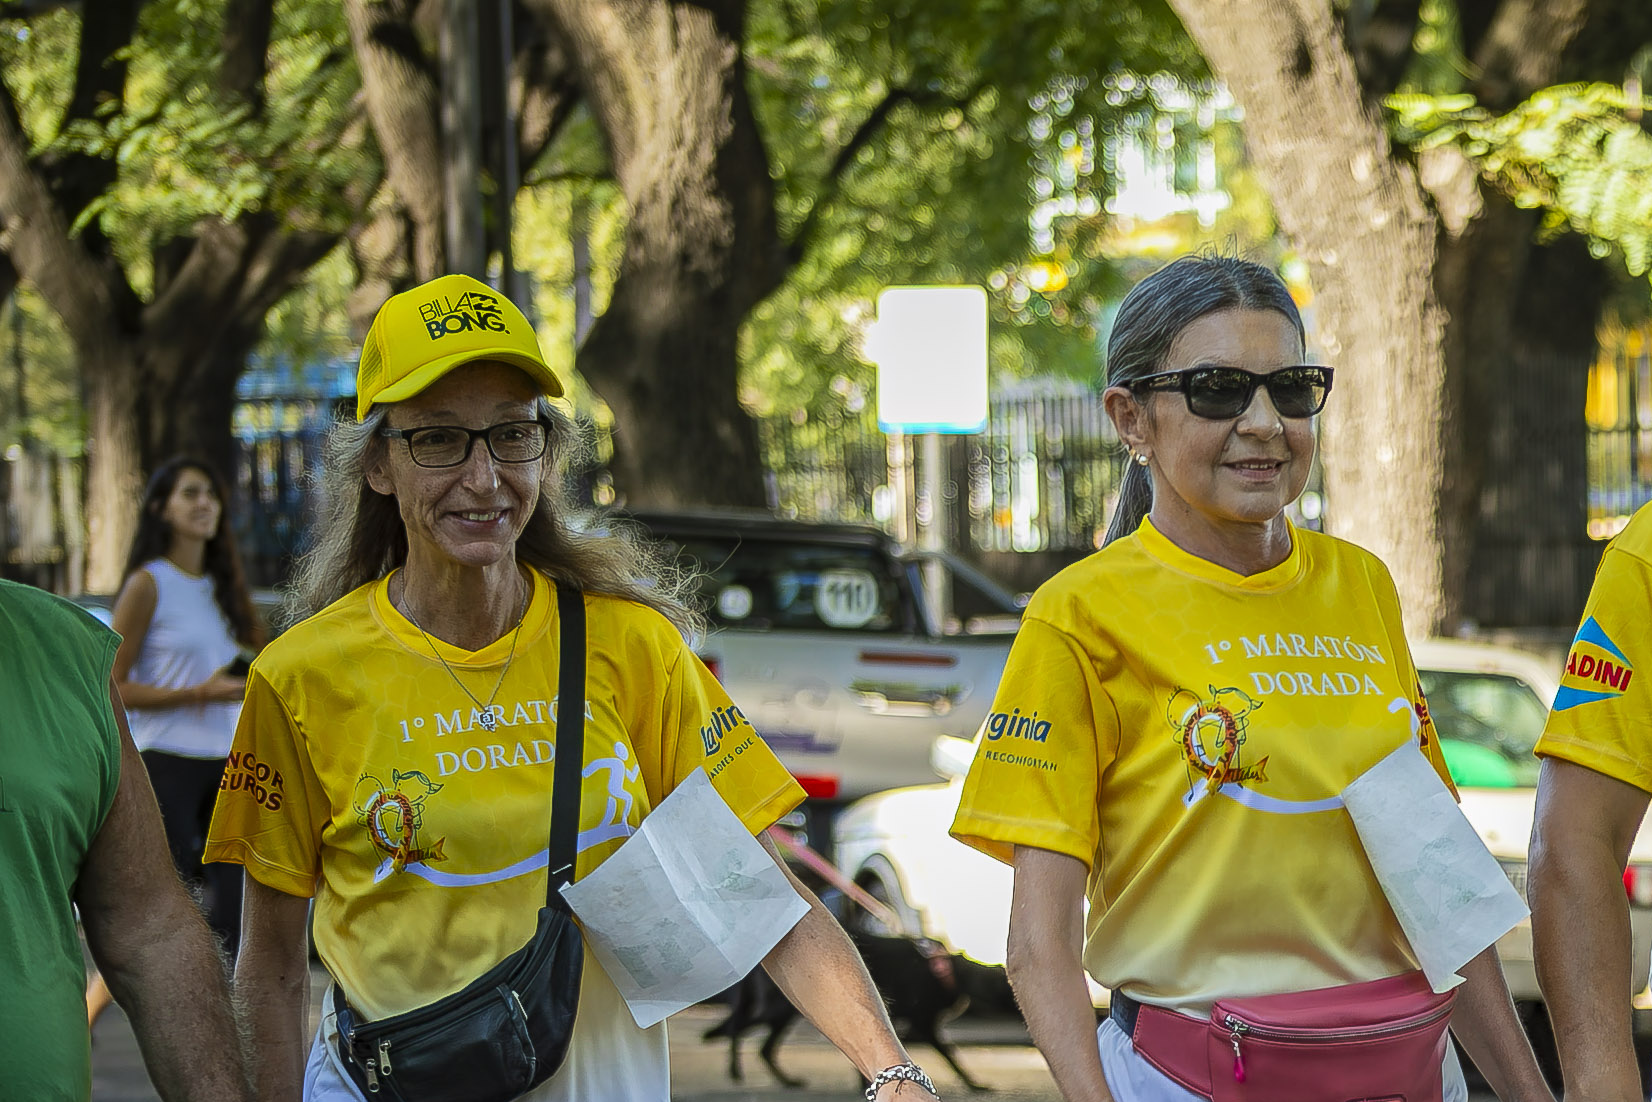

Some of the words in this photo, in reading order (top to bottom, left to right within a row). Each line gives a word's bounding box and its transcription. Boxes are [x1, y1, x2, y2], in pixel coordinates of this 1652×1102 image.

[1204, 640, 1232, 665] 1°
[1239, 632, 1387, 665] MARATÓN
[1249, 671, 1385, 696] DORADA
[399, 716, 425, 743] 1°
[435, 739, 557, 777] DORAD
[735, 737, 756, 756] QUE
